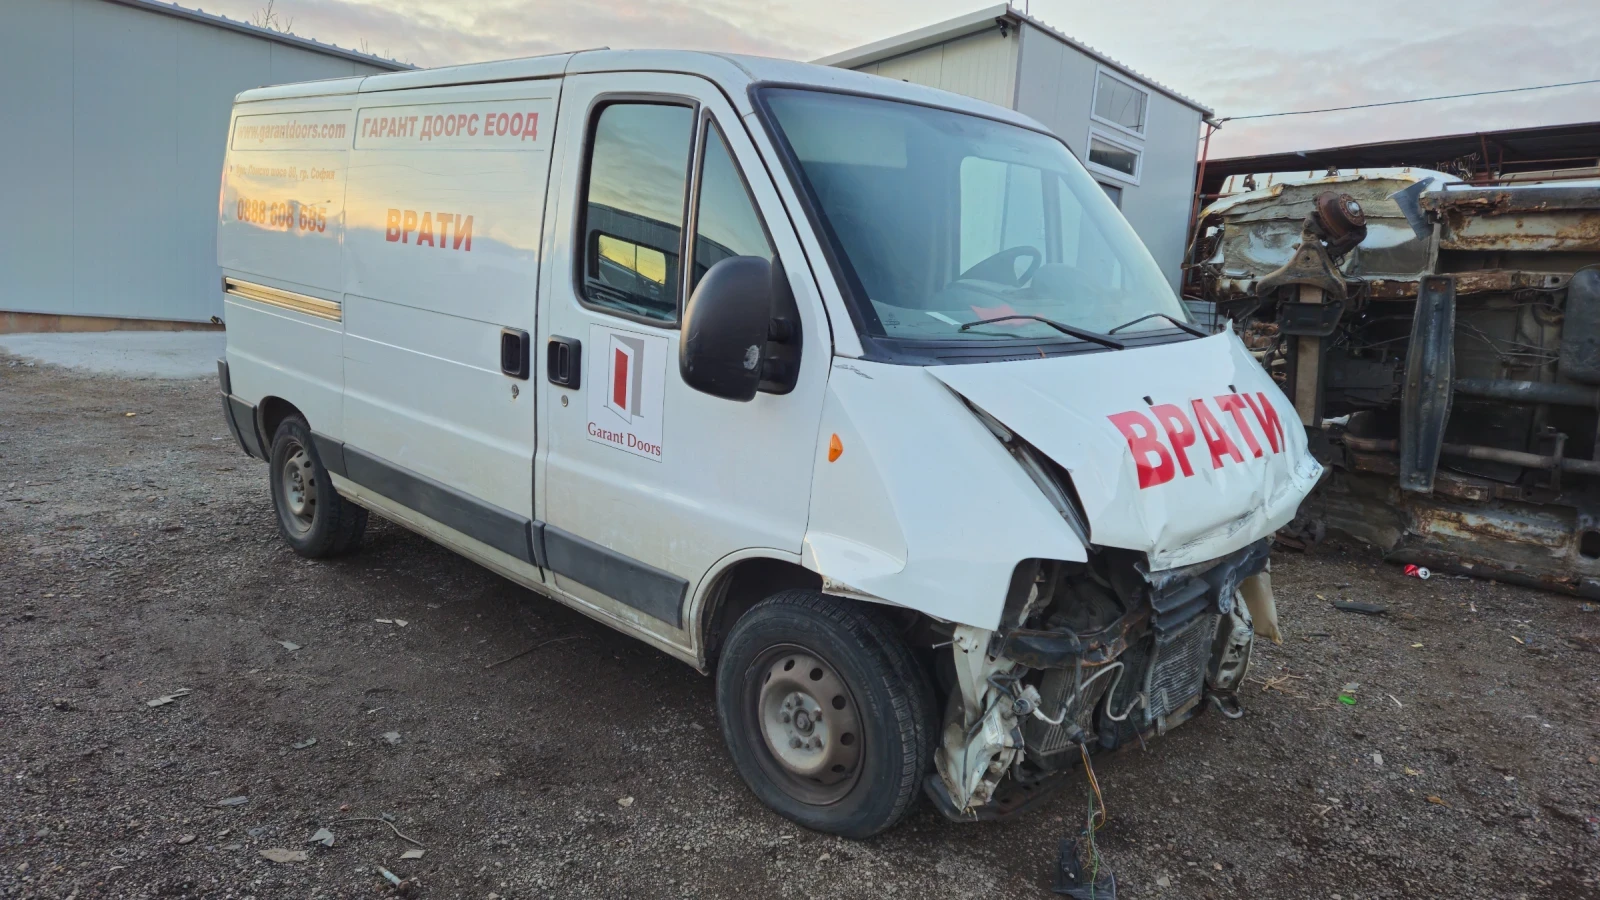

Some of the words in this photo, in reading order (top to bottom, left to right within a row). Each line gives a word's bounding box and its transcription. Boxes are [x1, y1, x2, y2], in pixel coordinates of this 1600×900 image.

[237, 120, 346, 143] www.garantdoors.com
[361, 116, 419, 139] ГАРАНТ
[420, 113, 479, 141] ДООРС
[484, 112, 539, 141] ЕООД
[300, 169, 309, 181] гр.
[311, 166, 336, 182] София
[237, 198, 266, 224] 0888
[270, 202, 294, 229] 608
[299, 205, 327, 233] 685
[385, 208, 474, 252] ВРАТИ
[588, 421, 624, 445] Garant
[627, 433, 661, 457] Doors
[1106, 392, 1286, 489] ВРАТИ
